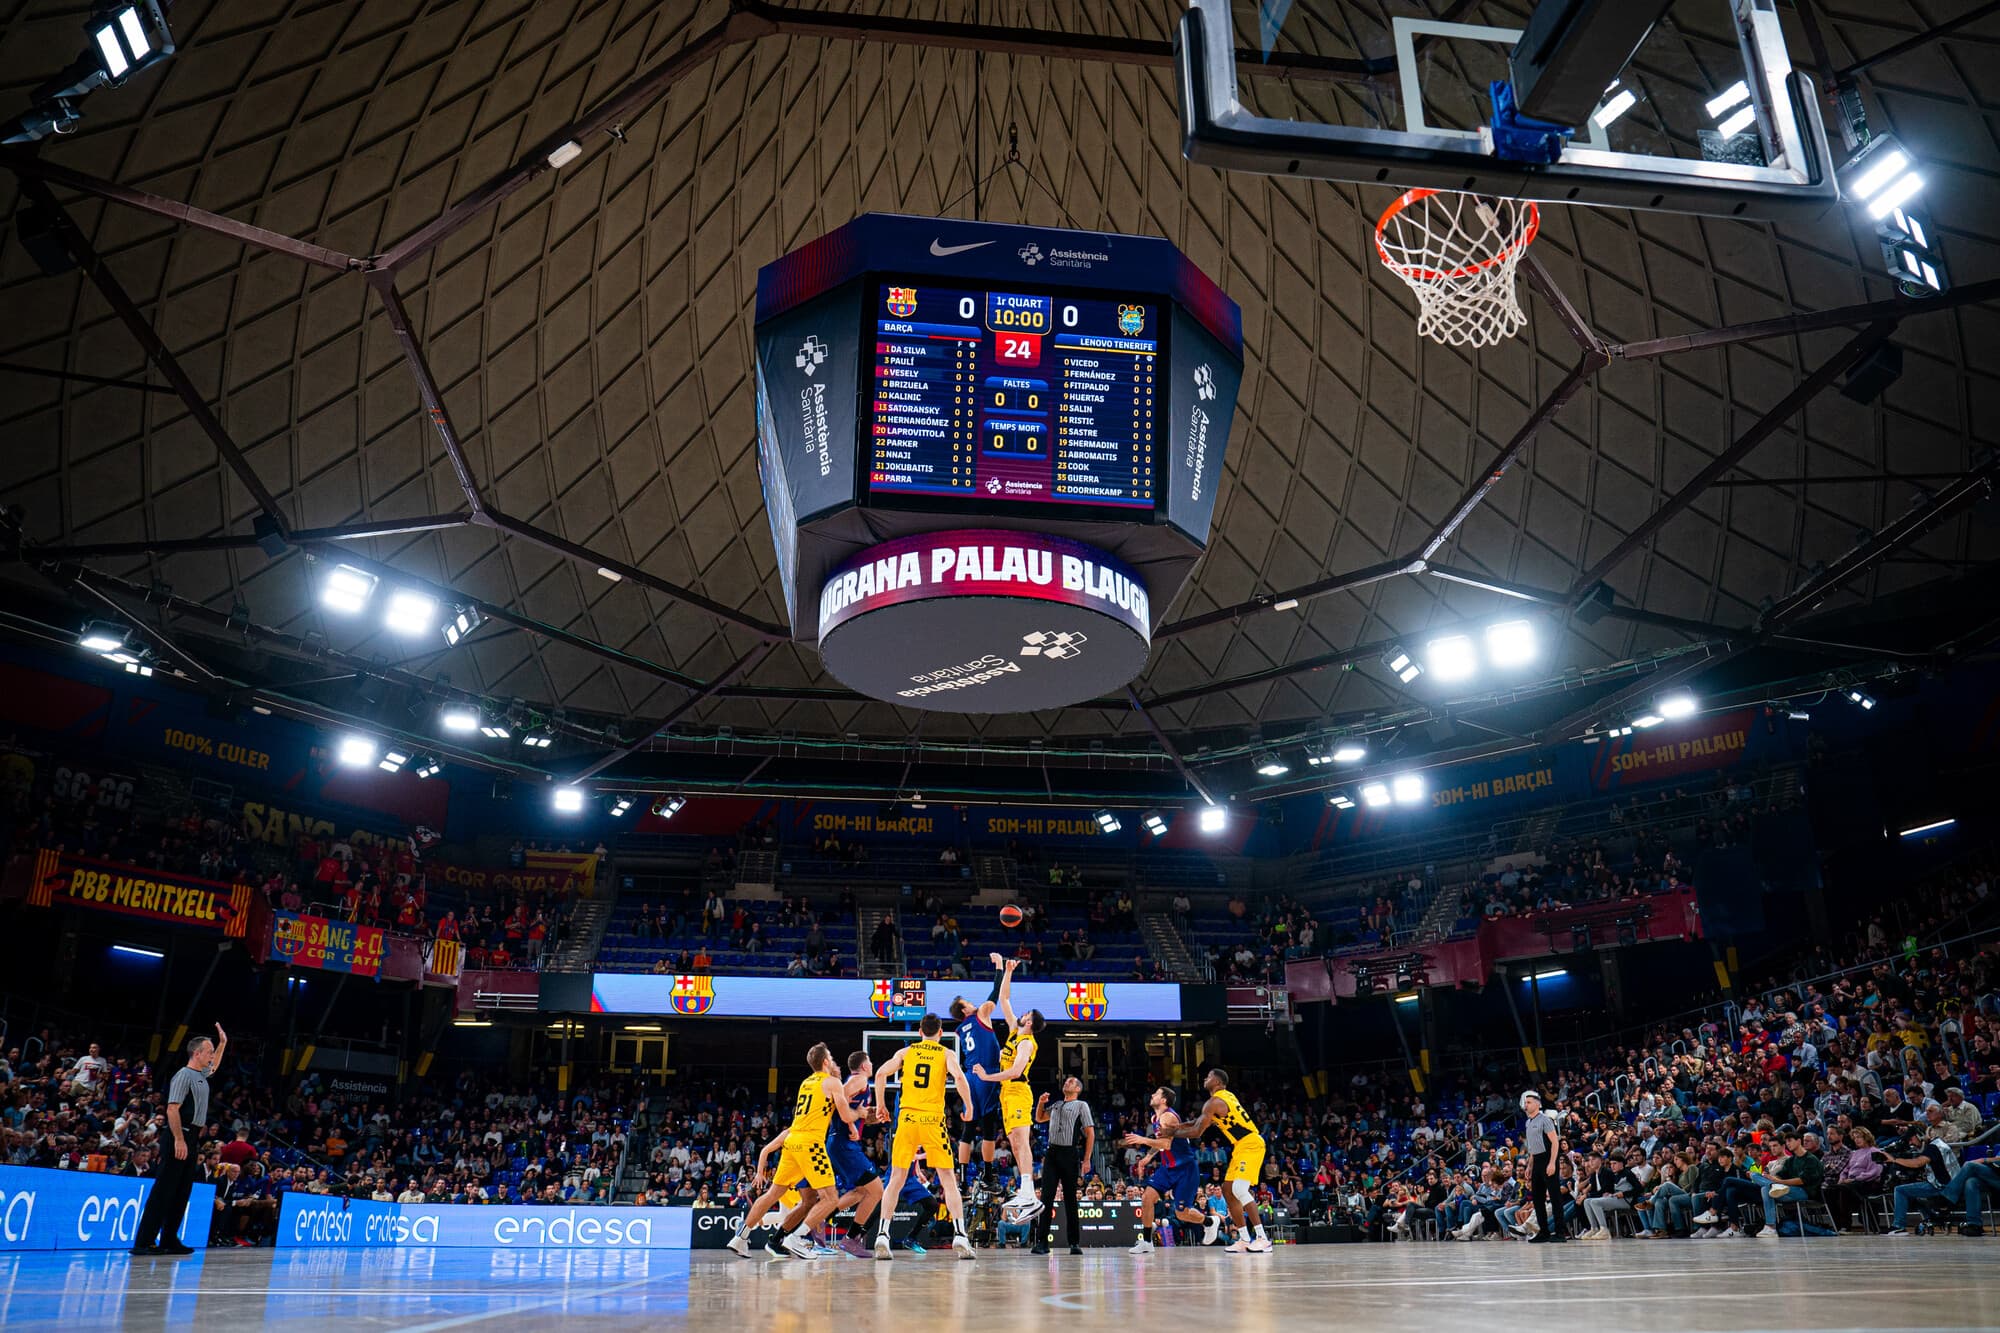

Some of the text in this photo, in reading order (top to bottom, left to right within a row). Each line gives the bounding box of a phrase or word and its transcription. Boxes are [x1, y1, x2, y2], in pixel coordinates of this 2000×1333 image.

[1050, 248, 1109, 261] Assistència
[1050, 256, 1091, 269] Sanitària
[959, 297, 975, 318] 0
[1008, 298, 1043, 308] QUART
[995, 309, 1044, 327] 10:00
[1063, 306, 1078, 326] 0
[885, 324, 913, 334] BARÇA
[1004, 339, 1031, 359] 24
[1081, 339, 1153, 350] LENOVO TENERIFE
[903, 347, 926, 355] SILVA
[969, 351, 975, 359] 0
[890, 357, 914, 366] PAULÍ
[1071, 359, 1098, 367] VICEDO
[890, 369, 919, 377] VESELY
[956, 373, 961, 381] 0
[969, 374, 974, 382] 0
[1071, 370, 1116, 381] FERNÁNDEZ
[890, 381, 928, 390] BRIZUELA
[1004, 380, 1030, 388] FALTES
[1070, 382, 1109, 391] FITIPALDO
[1134, 386, 1139, 394] 0
[889, 392, 921, 401] KALINIC
[968, 397, 973, 405] 0
[995, 393, 1038, 408] 0 0
[1070, 394, 1104, 402] HUERTAS
[888, 405, 940, 414] SATORANSKY
[954, 408, 960, 416] 0
[967, 409, 973, 417] 0
[1069, 405, 1092, 413] SALIN
[1133, 409, 1139, 417] 0
[801, 387, 817, 454] Sanitària
[888, 416, 949, 427] HERNANGÓMEZ
[991, 423, 1016, 431] TEMPS
[1069, 417, 1094, 425] RISTIC
[814, 384, 833, 476] Assistència
[888, 428, 945, 438] LAPROVITTOLA
[954, 431, 959, 439] 0
[967, 432, 972, 440] 0
[1069, 428, 1098, 436] SASTRE
[1133, 432, 1138, 440] 0
[887, 440, 918, 448] PARKER
[953, 443, 959, 451] 0
[994, 435, 1037, 451] 0 0
[1069, 440, 1118, 450] SHERMADINI
[886, 451, 910, 459] NNAJI
[1068, 452, 1117, 461] ABROMAITIS
[1191, 411, 1209, 501] Assistència
[886, 463, 933, 472] JOKUBAITIS
[1068, 463, 1089, 471] COOK
[885, 475, 912, 483] PARRA
[952, 478, 957, 486] 0
[1068, 475, 1099, 483] GUERRA
[1132, 478, 1138, 486] 0
[1067, 486, 1122, 496] DOORNEKAMP
[931, 547, 1052, 585] PALAU
[1061, 554, 1149, 626] BLAUGR
[910, 654, 1005, 683] Sanitària
[896, 661, 1021, 697] Assistència
[164, 728, 270, 770] 100% CULER
[1612, 730, 1745, 772] SOM-HI PALAU!
[1432, 769, 1552, 808] SOM-HI BARÇA!
[813, 814, 933, 836] SOM-HI BARÇA!
[988, 818, 1042, 833] SOM-HI
[70, 868, 216, 922] PBB MERITXELL
[308, 923, 351, 951] SANG
[307, 947, 335, 960] COR
[900, 981, 921, 989] 10:00
[905, 992, 925, 1007] 24
[965, 1031, 976, 1052] 6
[914, 1063, 931, 1089] 9
[795, 1094, 813, 1116] 21
[295, 1200, 352, 1242] endesa
[365, 1206, 440, 1243] endesa
[494, 1209, 653, 1245] endesa
